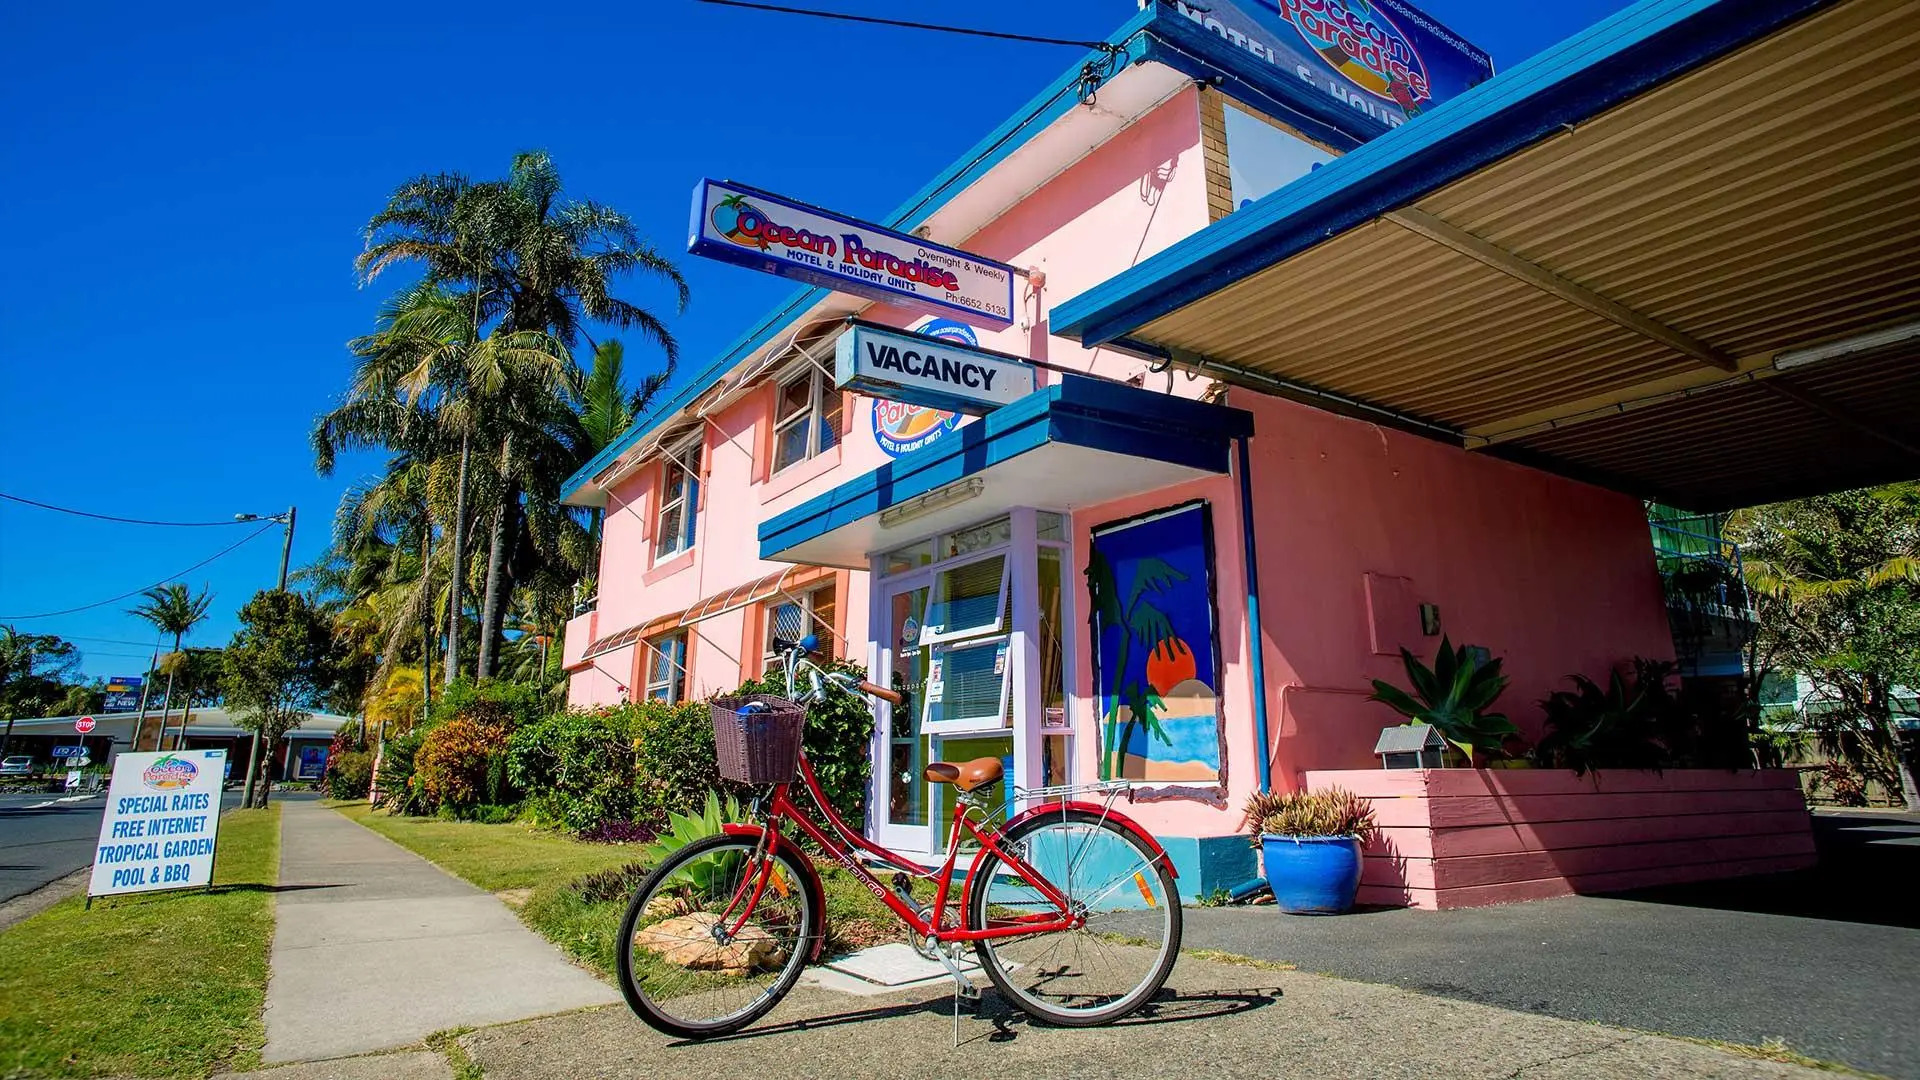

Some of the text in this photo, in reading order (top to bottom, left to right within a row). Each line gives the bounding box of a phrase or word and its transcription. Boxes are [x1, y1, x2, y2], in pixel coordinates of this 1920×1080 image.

[736, 211, 960, 292] Ocean Paradise
[786, 249, 916, 292] MOTEL & HOLIDAY UNITS
[917, 248, 1006, 282] Overnight & Weekly
[945, 291, 1007, 316] Ph:6652 5133
[866, 341, 997, 391] VACANCY
[151, 761, 192, 774] Ocean
[117, 793, 210, 815] SPECIAL RATES
[112, 816, 207, 839] FREE INTERNET
[99, 838, 213, 864] TROPICAL GARDEN
[112, 863, 190, 888] POOL & BBQ
